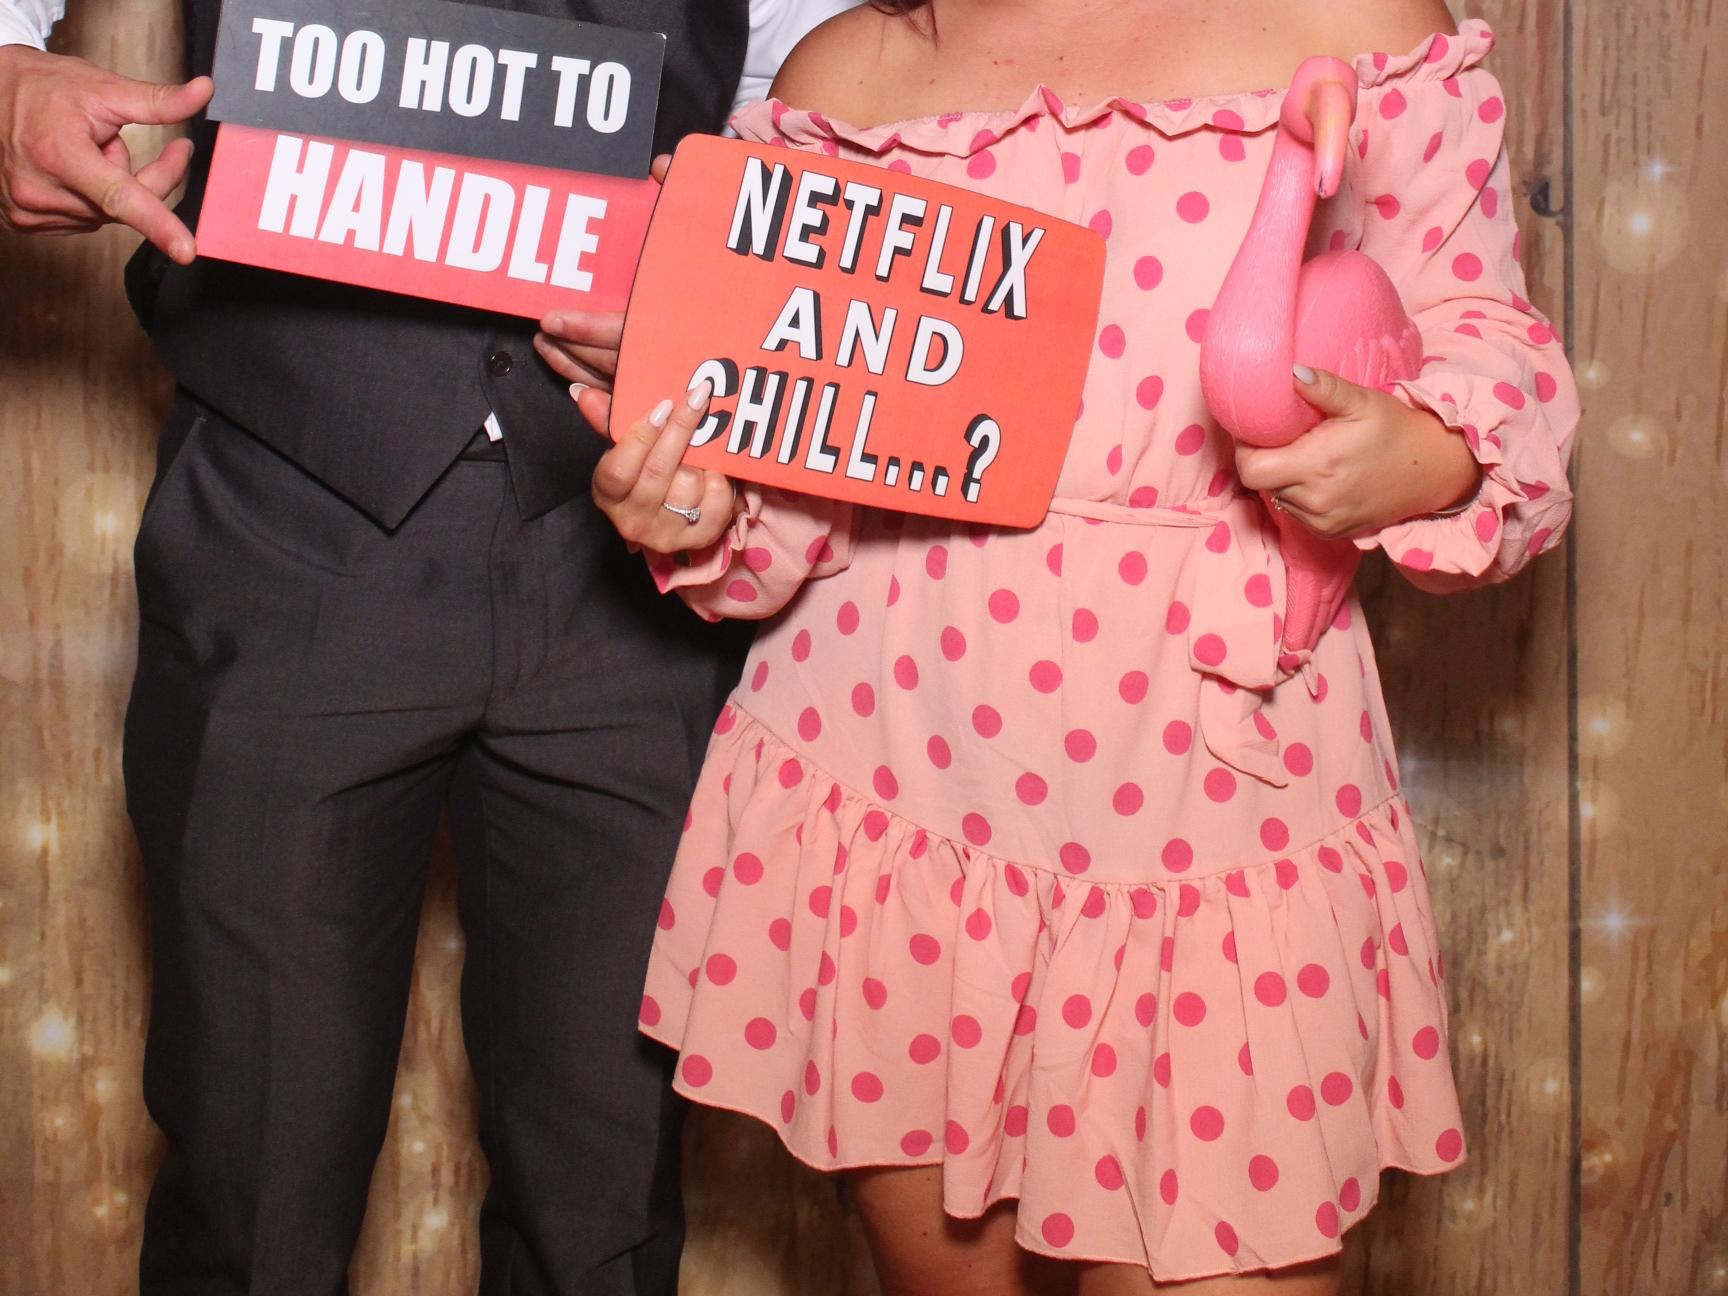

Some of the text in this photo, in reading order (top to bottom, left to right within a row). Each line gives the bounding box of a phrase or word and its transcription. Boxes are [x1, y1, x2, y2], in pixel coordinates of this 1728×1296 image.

[252, 17, 632, 134] TOO HOT TO
[257, 134, 608, 292] HANDLE
[726, 156, 1046, 320] NETFLIX
[760, 286, 965, 386] AND
